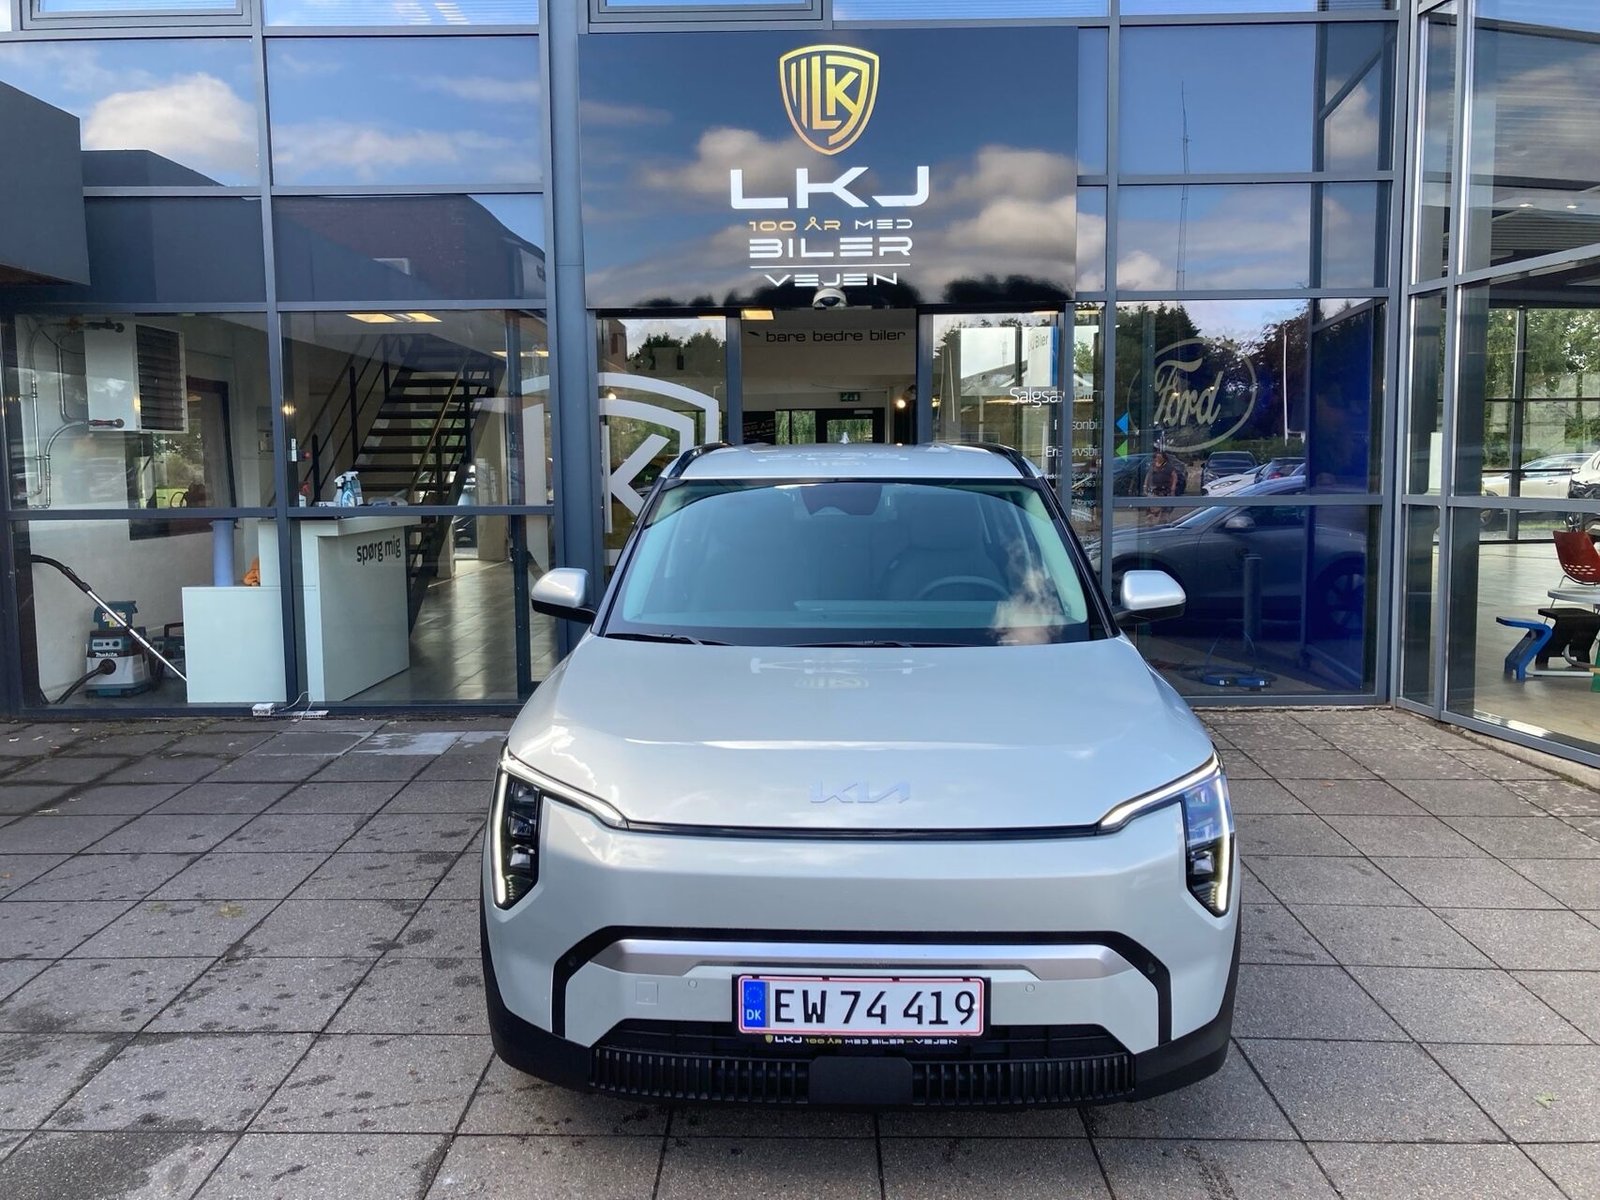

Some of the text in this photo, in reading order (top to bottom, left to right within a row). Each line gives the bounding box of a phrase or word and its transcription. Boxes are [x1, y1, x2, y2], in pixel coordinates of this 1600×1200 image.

[730, 165, 930, 209] LKJ
[749, 216, 913, 232] 100 ÅR MED
[749, 236, 913, 258] BILER
[764, 272, 898, 287] VEJEN
[766, 329, 906, 343] bare bedre biler
[1154, 358, 1224, 426] Ford
[356, 534, 402, 566] spørg mig
[746, 1009, 762, 1021] DK
[774, 989, 976, 1026] EW 74 419
[774, 1035, 802, 1044] LKJ
